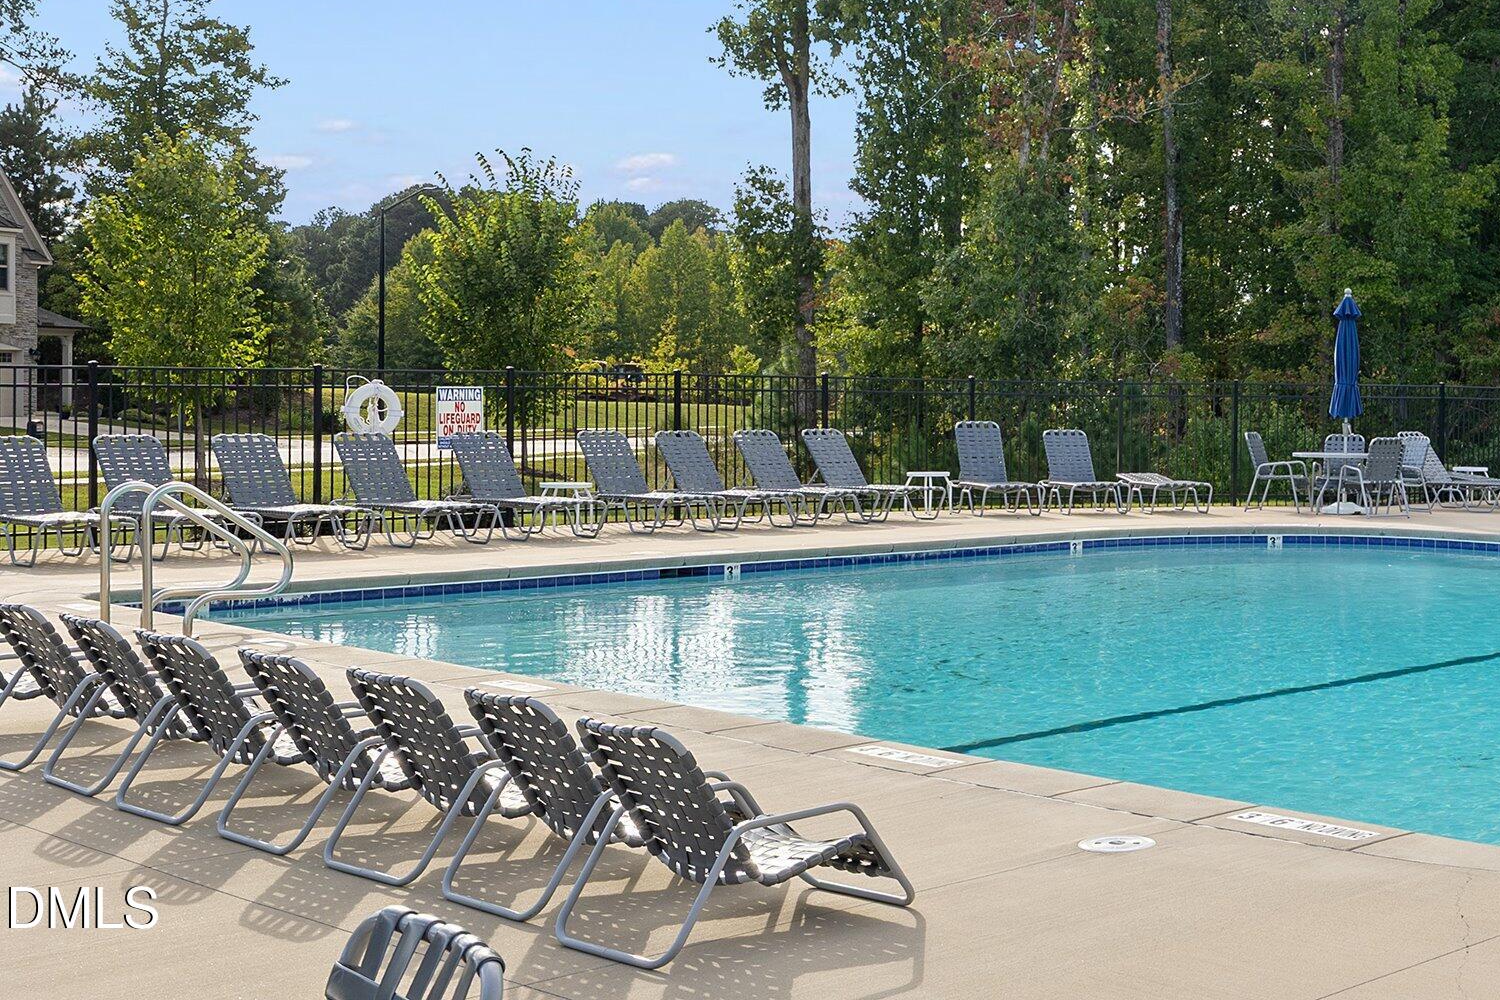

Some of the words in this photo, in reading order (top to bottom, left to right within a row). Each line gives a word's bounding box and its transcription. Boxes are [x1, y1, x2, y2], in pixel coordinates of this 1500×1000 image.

[439, 388, 481, 401] WARNING
[454, 402, 466, 412] NO
[439, 413, 481, 424] LIFEGUARD
[443, 425, 454, 436] ON
